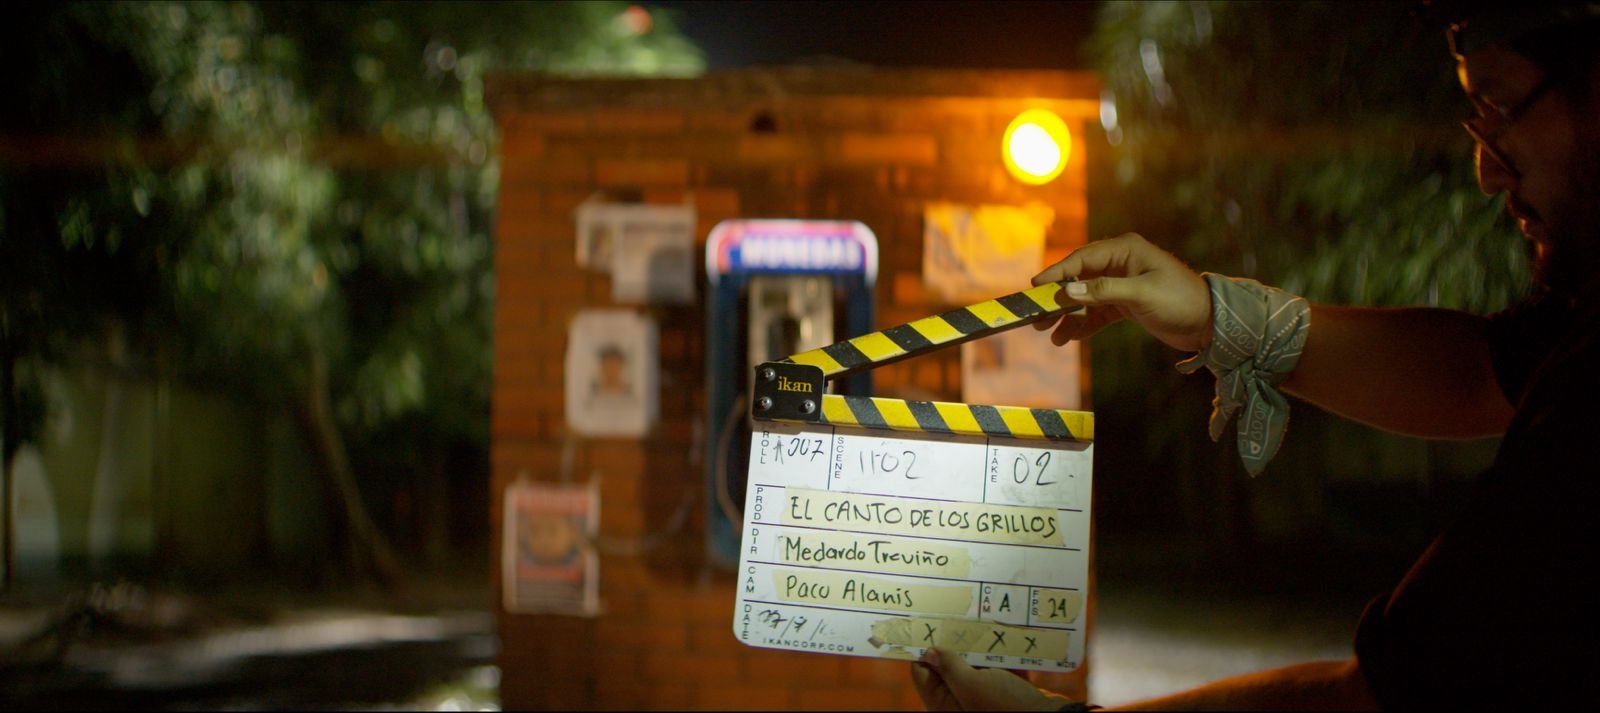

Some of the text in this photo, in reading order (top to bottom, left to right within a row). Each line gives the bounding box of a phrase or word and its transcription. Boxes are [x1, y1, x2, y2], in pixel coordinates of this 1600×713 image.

[777, 376, 813, 393] ikan
[834, 436, 845, 479] SCENE
[990, 448, 999, 483] TAKE
[753, 487, 764, 520] PROD
[790, 496, 1057, 539] EL CANTO DE LOS GRILLOS
[785, 536, 949, 567] Medardo Treviño
[842, 579, 914, 608] Alanis
